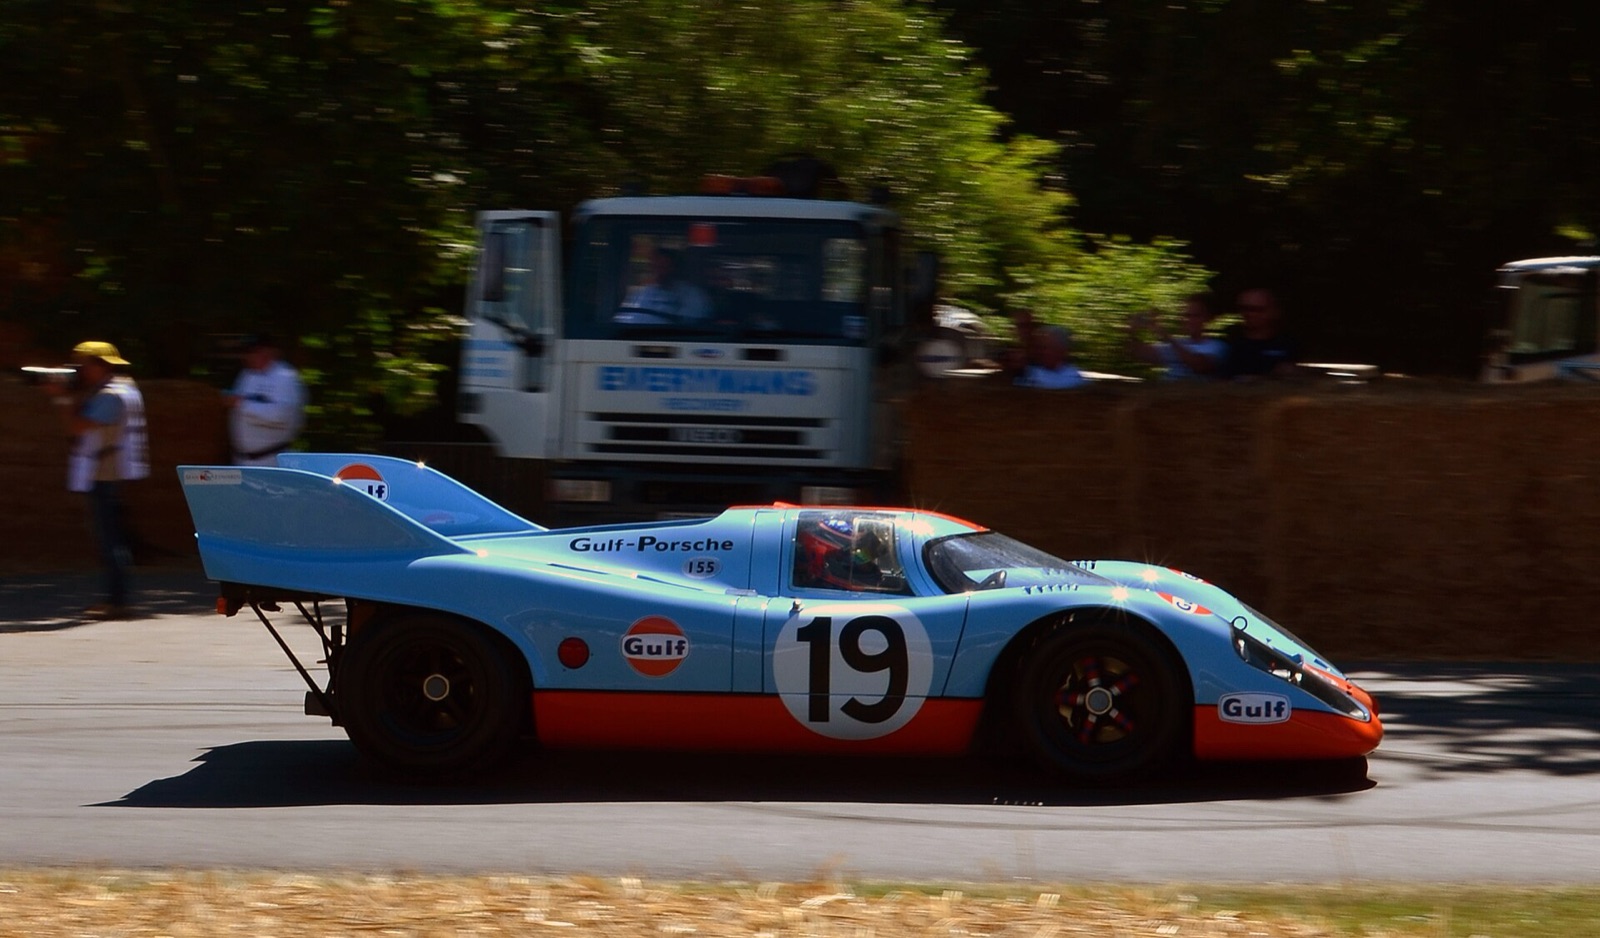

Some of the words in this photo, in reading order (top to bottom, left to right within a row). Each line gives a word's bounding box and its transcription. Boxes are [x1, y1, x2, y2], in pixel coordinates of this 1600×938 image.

[569, 536, 734, 553] Gulf-Porsche
[688, 561, 715, 573] 155
[624, 638, 687, 656] Gulf
[796, 615, 909, 724] 19
[1222, 698, 1286, 718] Gulf
